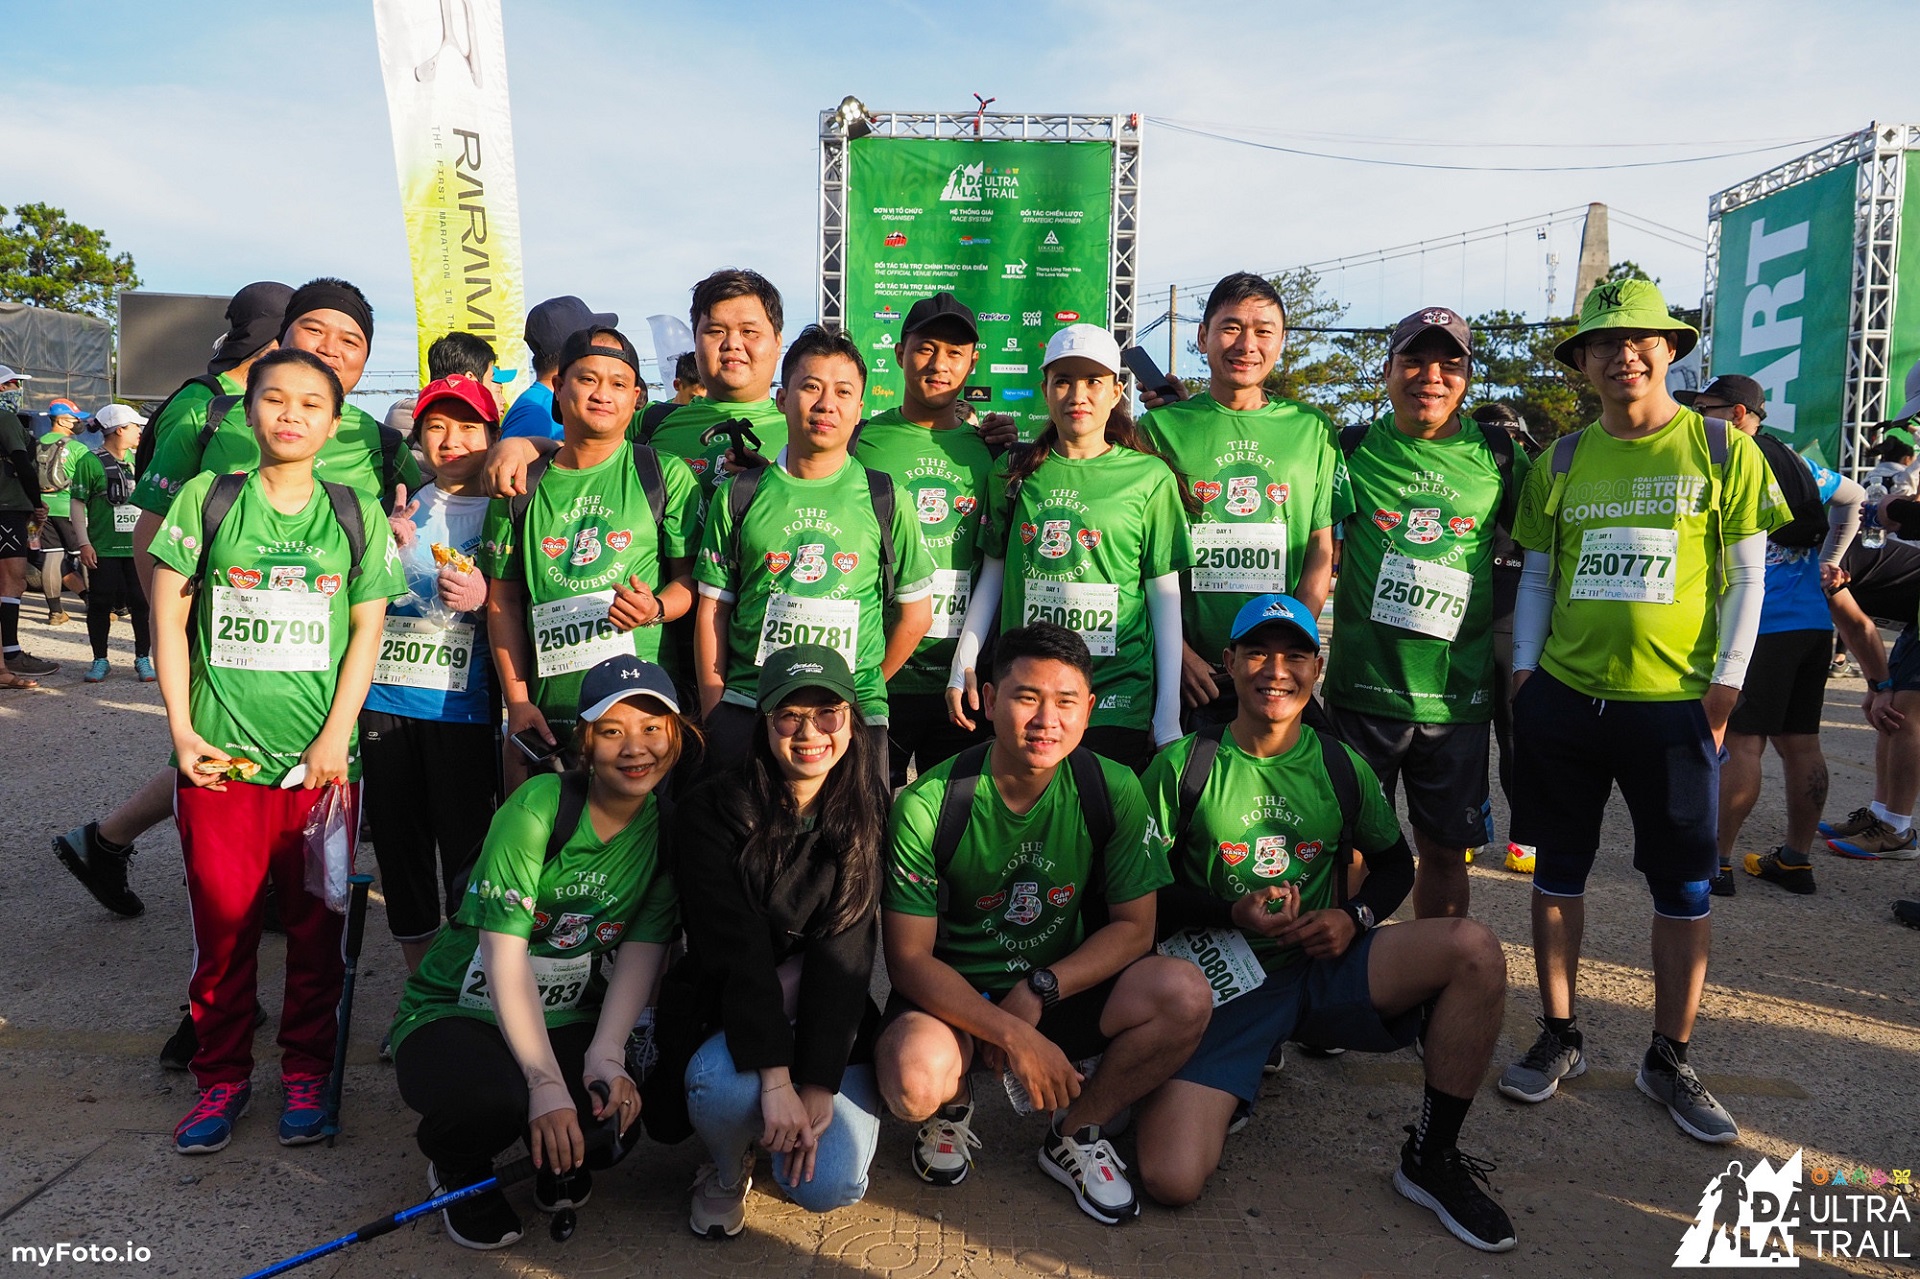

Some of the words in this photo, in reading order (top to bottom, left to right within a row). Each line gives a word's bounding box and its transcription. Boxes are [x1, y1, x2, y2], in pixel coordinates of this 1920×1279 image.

[431, 125, 443, 149] THE
[437, 160, 446, 202] FIRST
[984, 176, 1019, 187] ULTRA
[985, 188, 1019, 199] TRAIL
[439, 212, 451, 279] MARATHON
[1005, 264, 1024, 274] TTC
[445, 289, 453, 304] IN
[1022, 318, 1042, 326] XIM
[1741, 217, 1811, 449] ART
[1227, 440, 1259, 451] THE
[917, 458, 948, 468] THE
[1214, 451, 1275, 469] FOREST
[904, 467, 962, 484] FOREST
[1412, 470, 1445, 483] THE
[1050, 489, 1079, 499] THE
[1225, 476, 1262, 516] 5
[1398, 482, 1461, 501] FOREST
[1563, 479, 1631, 505] 2020
[1632, 480, 1653, 491] FOR
[1654, 481, 1705, 499] TRUE
[1632, 490, 1652, 498] THE
[574, 495, 601, 508] THE
[1036, 498, 1090, 515] FOREST
[561, 505, 614, 523] FOREST
[795, 507, 828, 519] THE
[1563, 499, 1701, 523] CONQUERORS
[783, 518, 842, 537] FOREST
[1404, 508, 1444, 545] 5
[272, 540, 306, 549] THE
[570, 526, 602, 566] 5
[1038, 520, 1072, 559] 5
[256, 545, 326, 559] FOREST
[1195, 547, 1280, 570] 250801
[790, 543, 828, 584] 5
[1406, 563, 1417, 571] DAY
[1577, 553, 1672, 579] 250777
[229, 573, 259, 583] THANKS
[548, 562, 625, 592] CONQUEROR
[1229, 582, 1245, 590] true
[1046, 585, 1056, 593] DAY
[1604, 589, 1622, 597] true
[1622, 591, 1646, 599] WATER
[787, 601, 797, 609] DAY
[933, 594, 967, 615] 764
[1378, 578, 1465, 619] 250775
[551, 605, 561, 613] DAY
[1026, 604, 1113, 632] 250802
[217, 615, 325, 645] 250790
[1404, 619, 1421, 629] true
[538, 617, 624, 653] 25076
[764, 619, 852, 649] 250781
[380, 639, 468, 669] 250769
[574, 660, 590, 668] true
[1253, 795, 1287, 808] THE
[1240, 808, 1304, 827] FOREST
[1222, 848, 1247, 857] HANKS
[1252, 835, 1290, 878] 5
[575, 871, 609, 886] THE
[554, 884, 618, 906] FOREST
[1004, 882, 1042, 926] 5
[1053, 891, 1070, 900] CAN
[981, 915, 1066, 952] CONQUEROR
